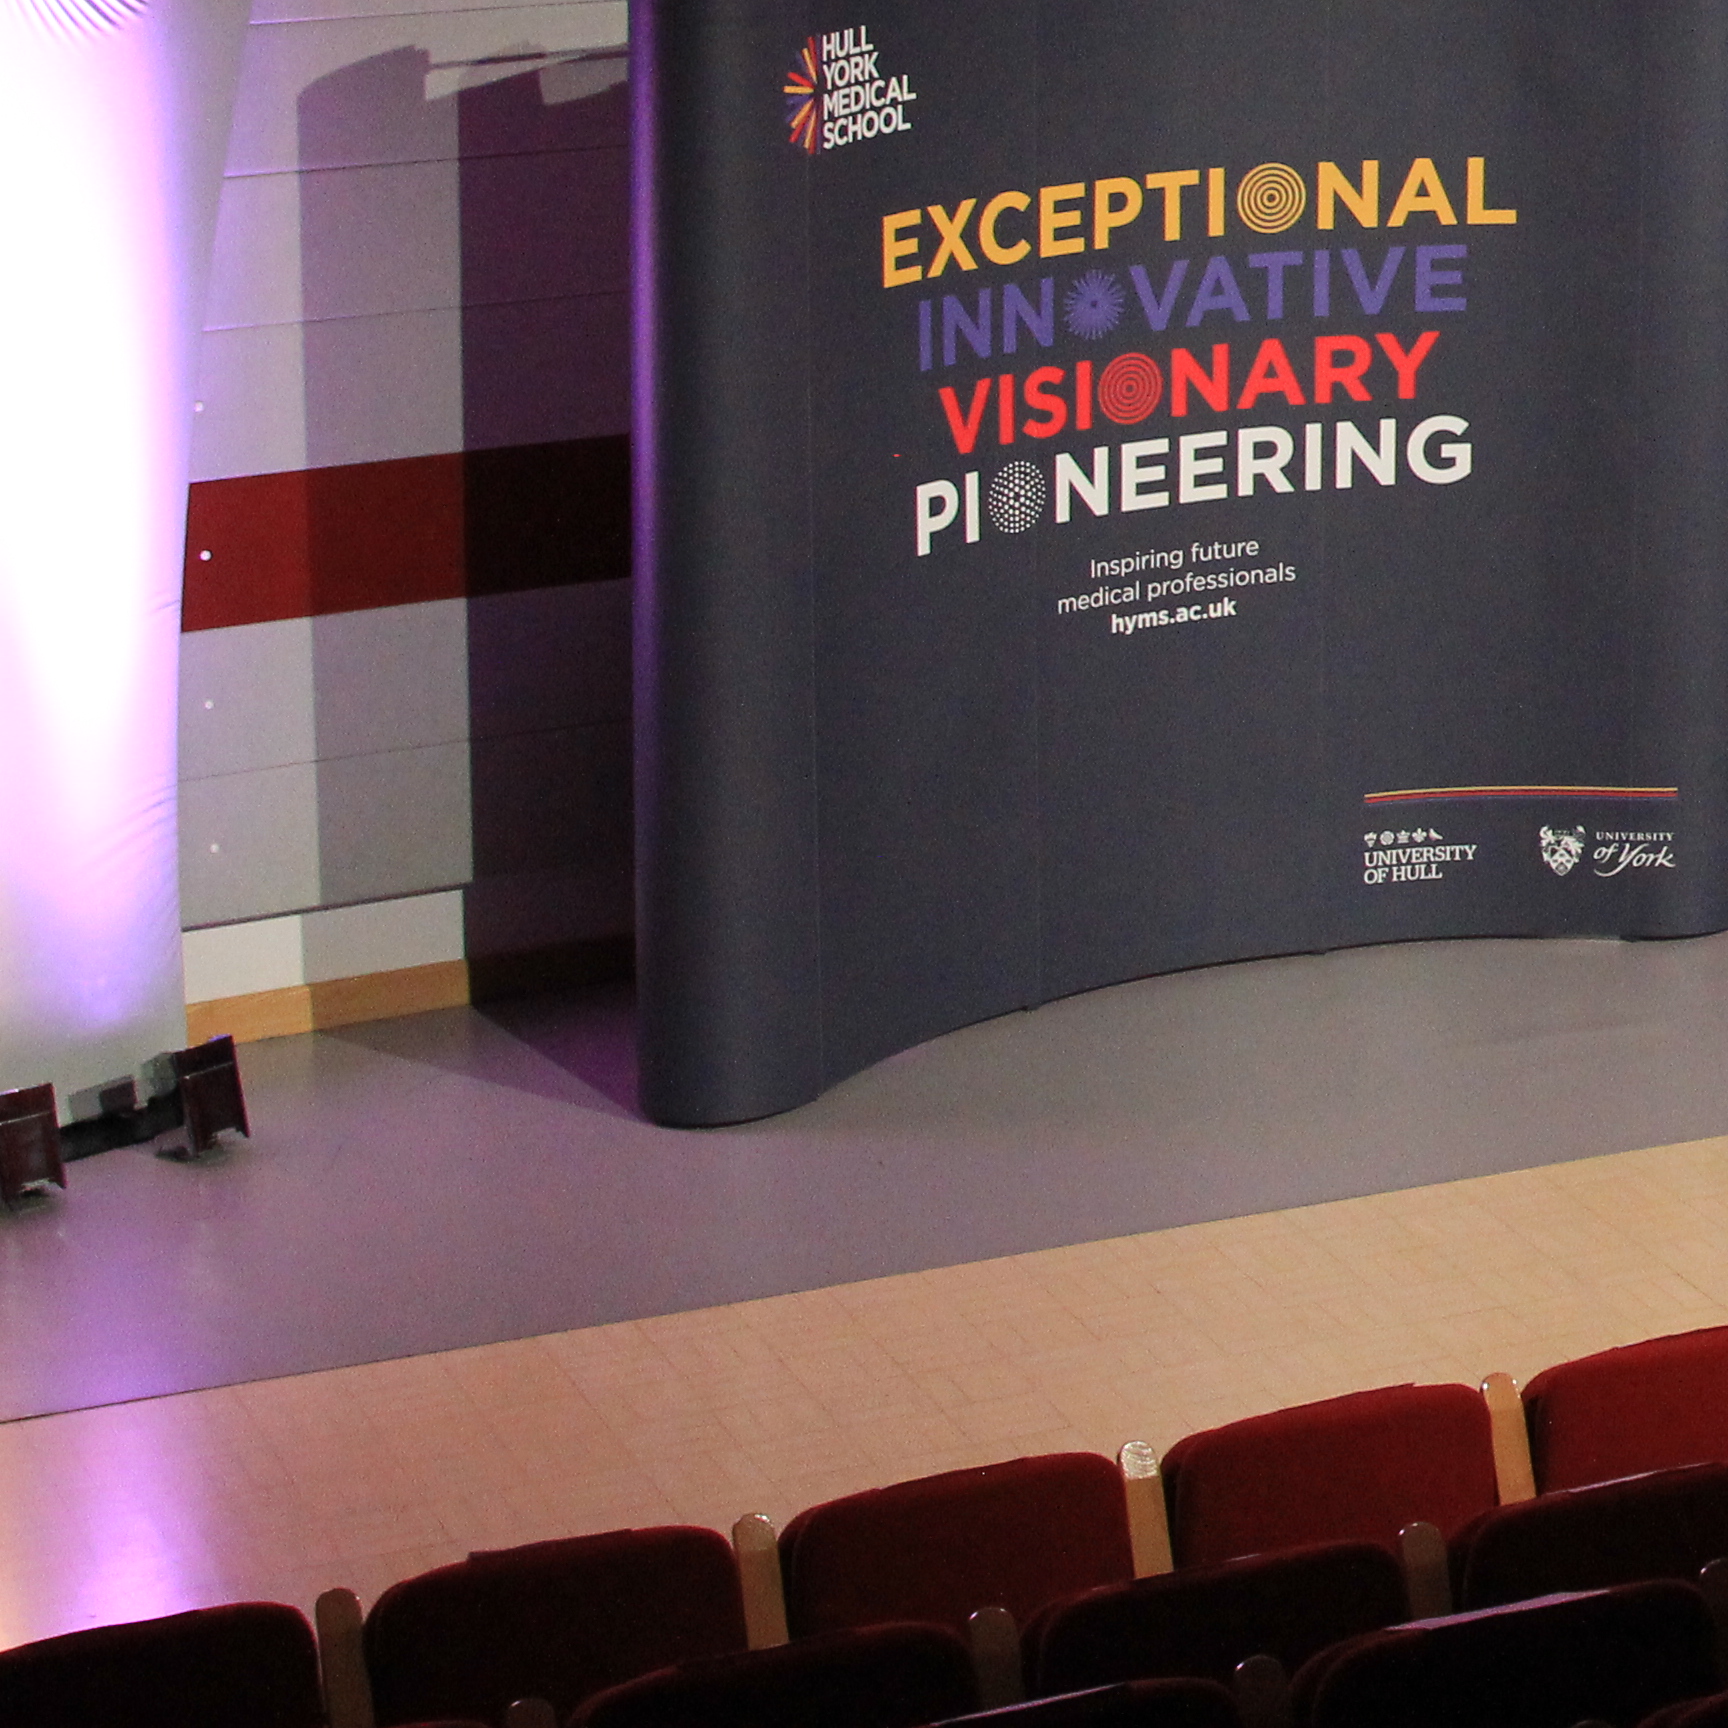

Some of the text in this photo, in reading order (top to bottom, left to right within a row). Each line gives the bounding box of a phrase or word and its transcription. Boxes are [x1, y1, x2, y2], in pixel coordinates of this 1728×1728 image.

[822, 25, 874, 62] HULL
[822, 51, 880, 90] YORK
[823, 74, 918, 121] MEDICAL
[822, 104, 912, 150] SCHOOL
[881, 156, 1518, 289] EXCEPTIONAL
[917, 243, 1469, 372] INNOVATIVE
[937, 330, 1440, 455] VISIONARY
[914, 413, 1472, 557] PIONEERING
[1090, 540, 1260, 578] Inspiring future
[1057, 562, 1296, 614] medical professionals
[1111, 597, 1237, 635] hyms.ac.uk
[1364, 844, 1477, 867] UNIVERSITY
[1595, 831, 1674, 841] UNIVERSITY
[1364, 864, 1442, 884] OF HULL
[1593, 843, 1676, 877] of York
